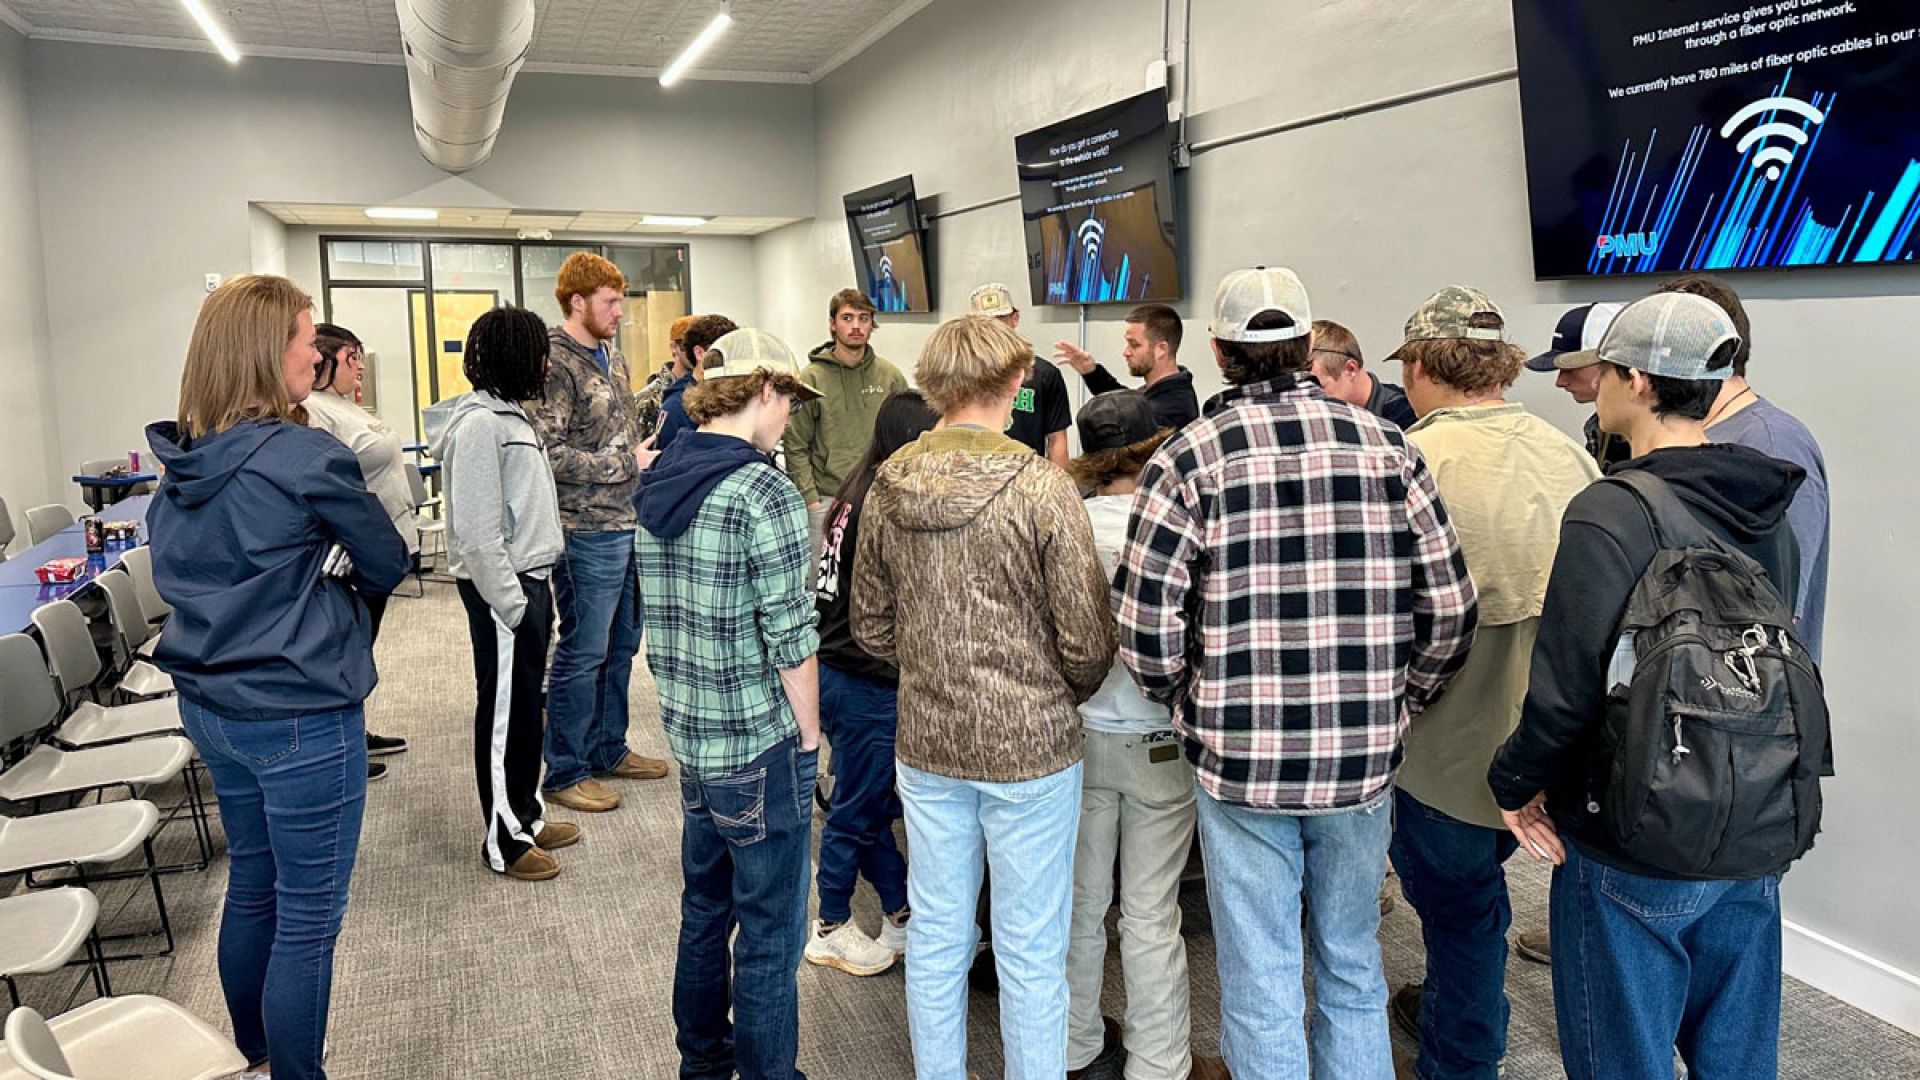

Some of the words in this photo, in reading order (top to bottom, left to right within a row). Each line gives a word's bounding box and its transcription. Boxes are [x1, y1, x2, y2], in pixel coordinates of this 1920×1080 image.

[1633, 32, 1655, 47] PMU
[1657, 21, 1700, 41] Internet
[1701, 12, 1740, 30] service
[1742, 4, 1774, 23] gives
[1776, 0, 1798, 15] you
[1684, 30, 1727, 49] through
[1729, 30, 1737, 39] a
[1739, 21, 1767, 37] fiber
[1768, 13, 1800, 32] optic
[1802, 1, 1857, 23] network.
[1608, 87, 1625, 99] We
[1625, 77, 1669, 95] currently
[1670, 73, 1697, 87] have
[1698, 66, 1718, 81] 780
[1719, 61, 1748, 76] miles
[1750, 55, 1764, 70] of
[1765, 52, 1794, 68] fiber
[1796, 44, 1828, 63] optic
[1829, 37, 1873, 55] cables
[1874, 31, 1889, 46] in
[1890, 28, 1916, 43] our
[1597, 231, 1657, 259] PMU
